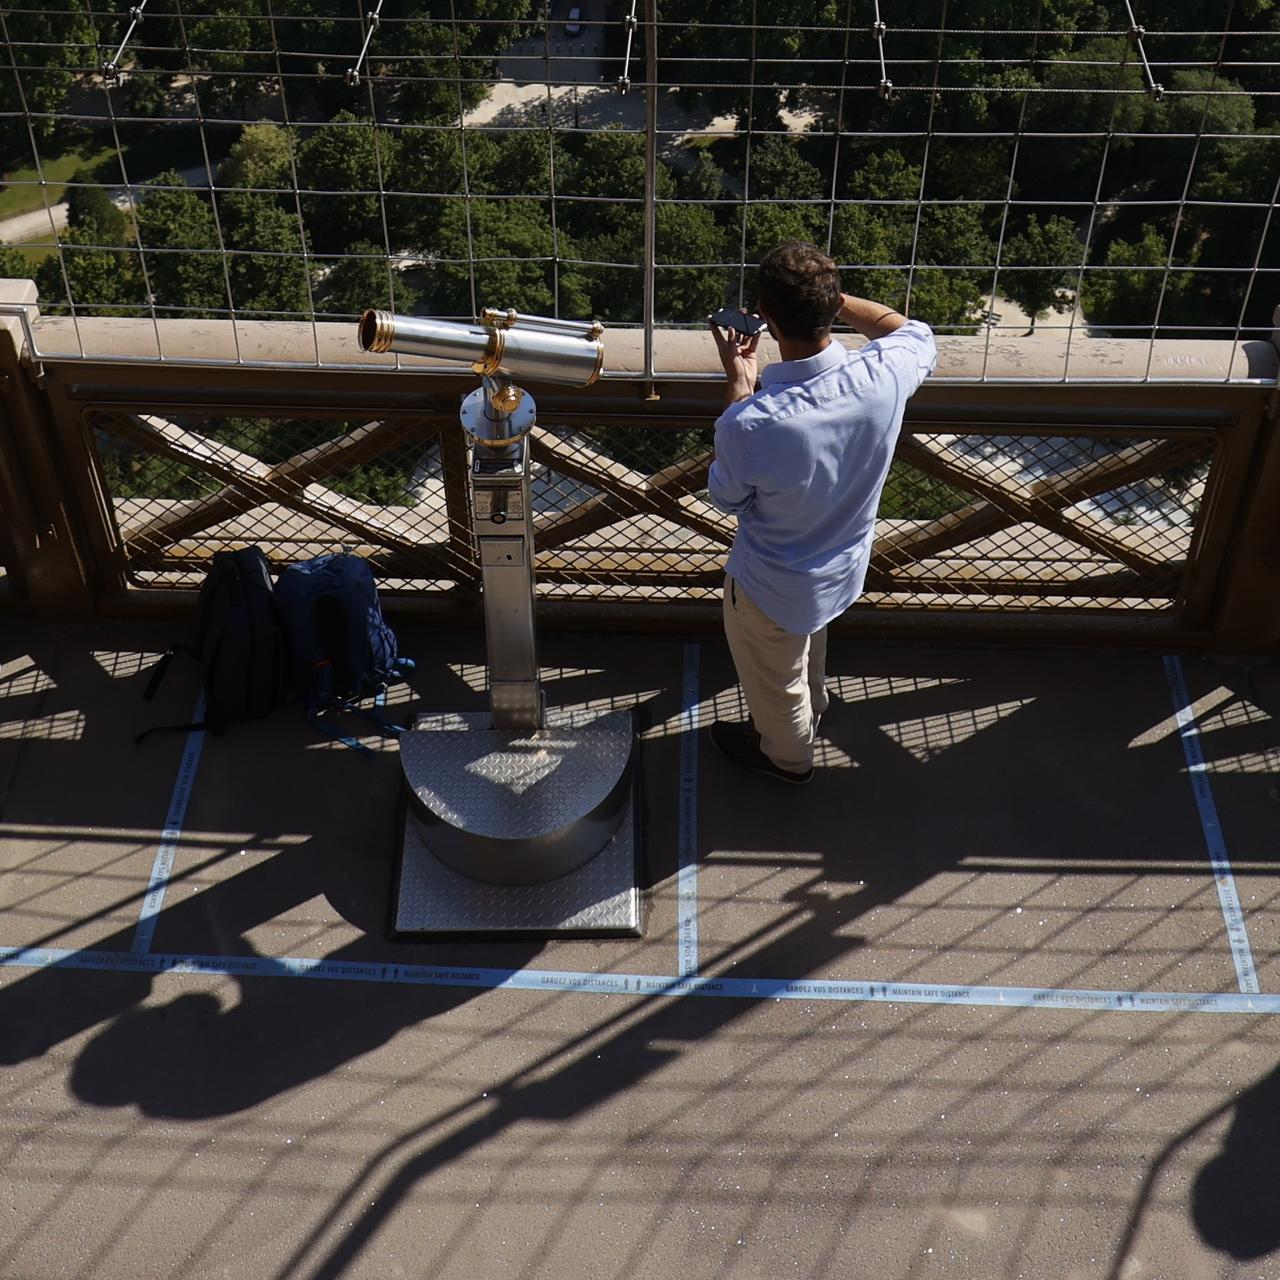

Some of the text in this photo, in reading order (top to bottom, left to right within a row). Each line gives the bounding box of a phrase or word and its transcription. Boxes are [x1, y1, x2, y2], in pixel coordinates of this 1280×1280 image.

[541, 976, 619, 988] GARDEZ VOS DISTANCES
[785, 984, 865, 995] GARDEZ VOS DISTANCES
[892, 988, 971, 999] MAINTAIN SAFE DISTANCE
